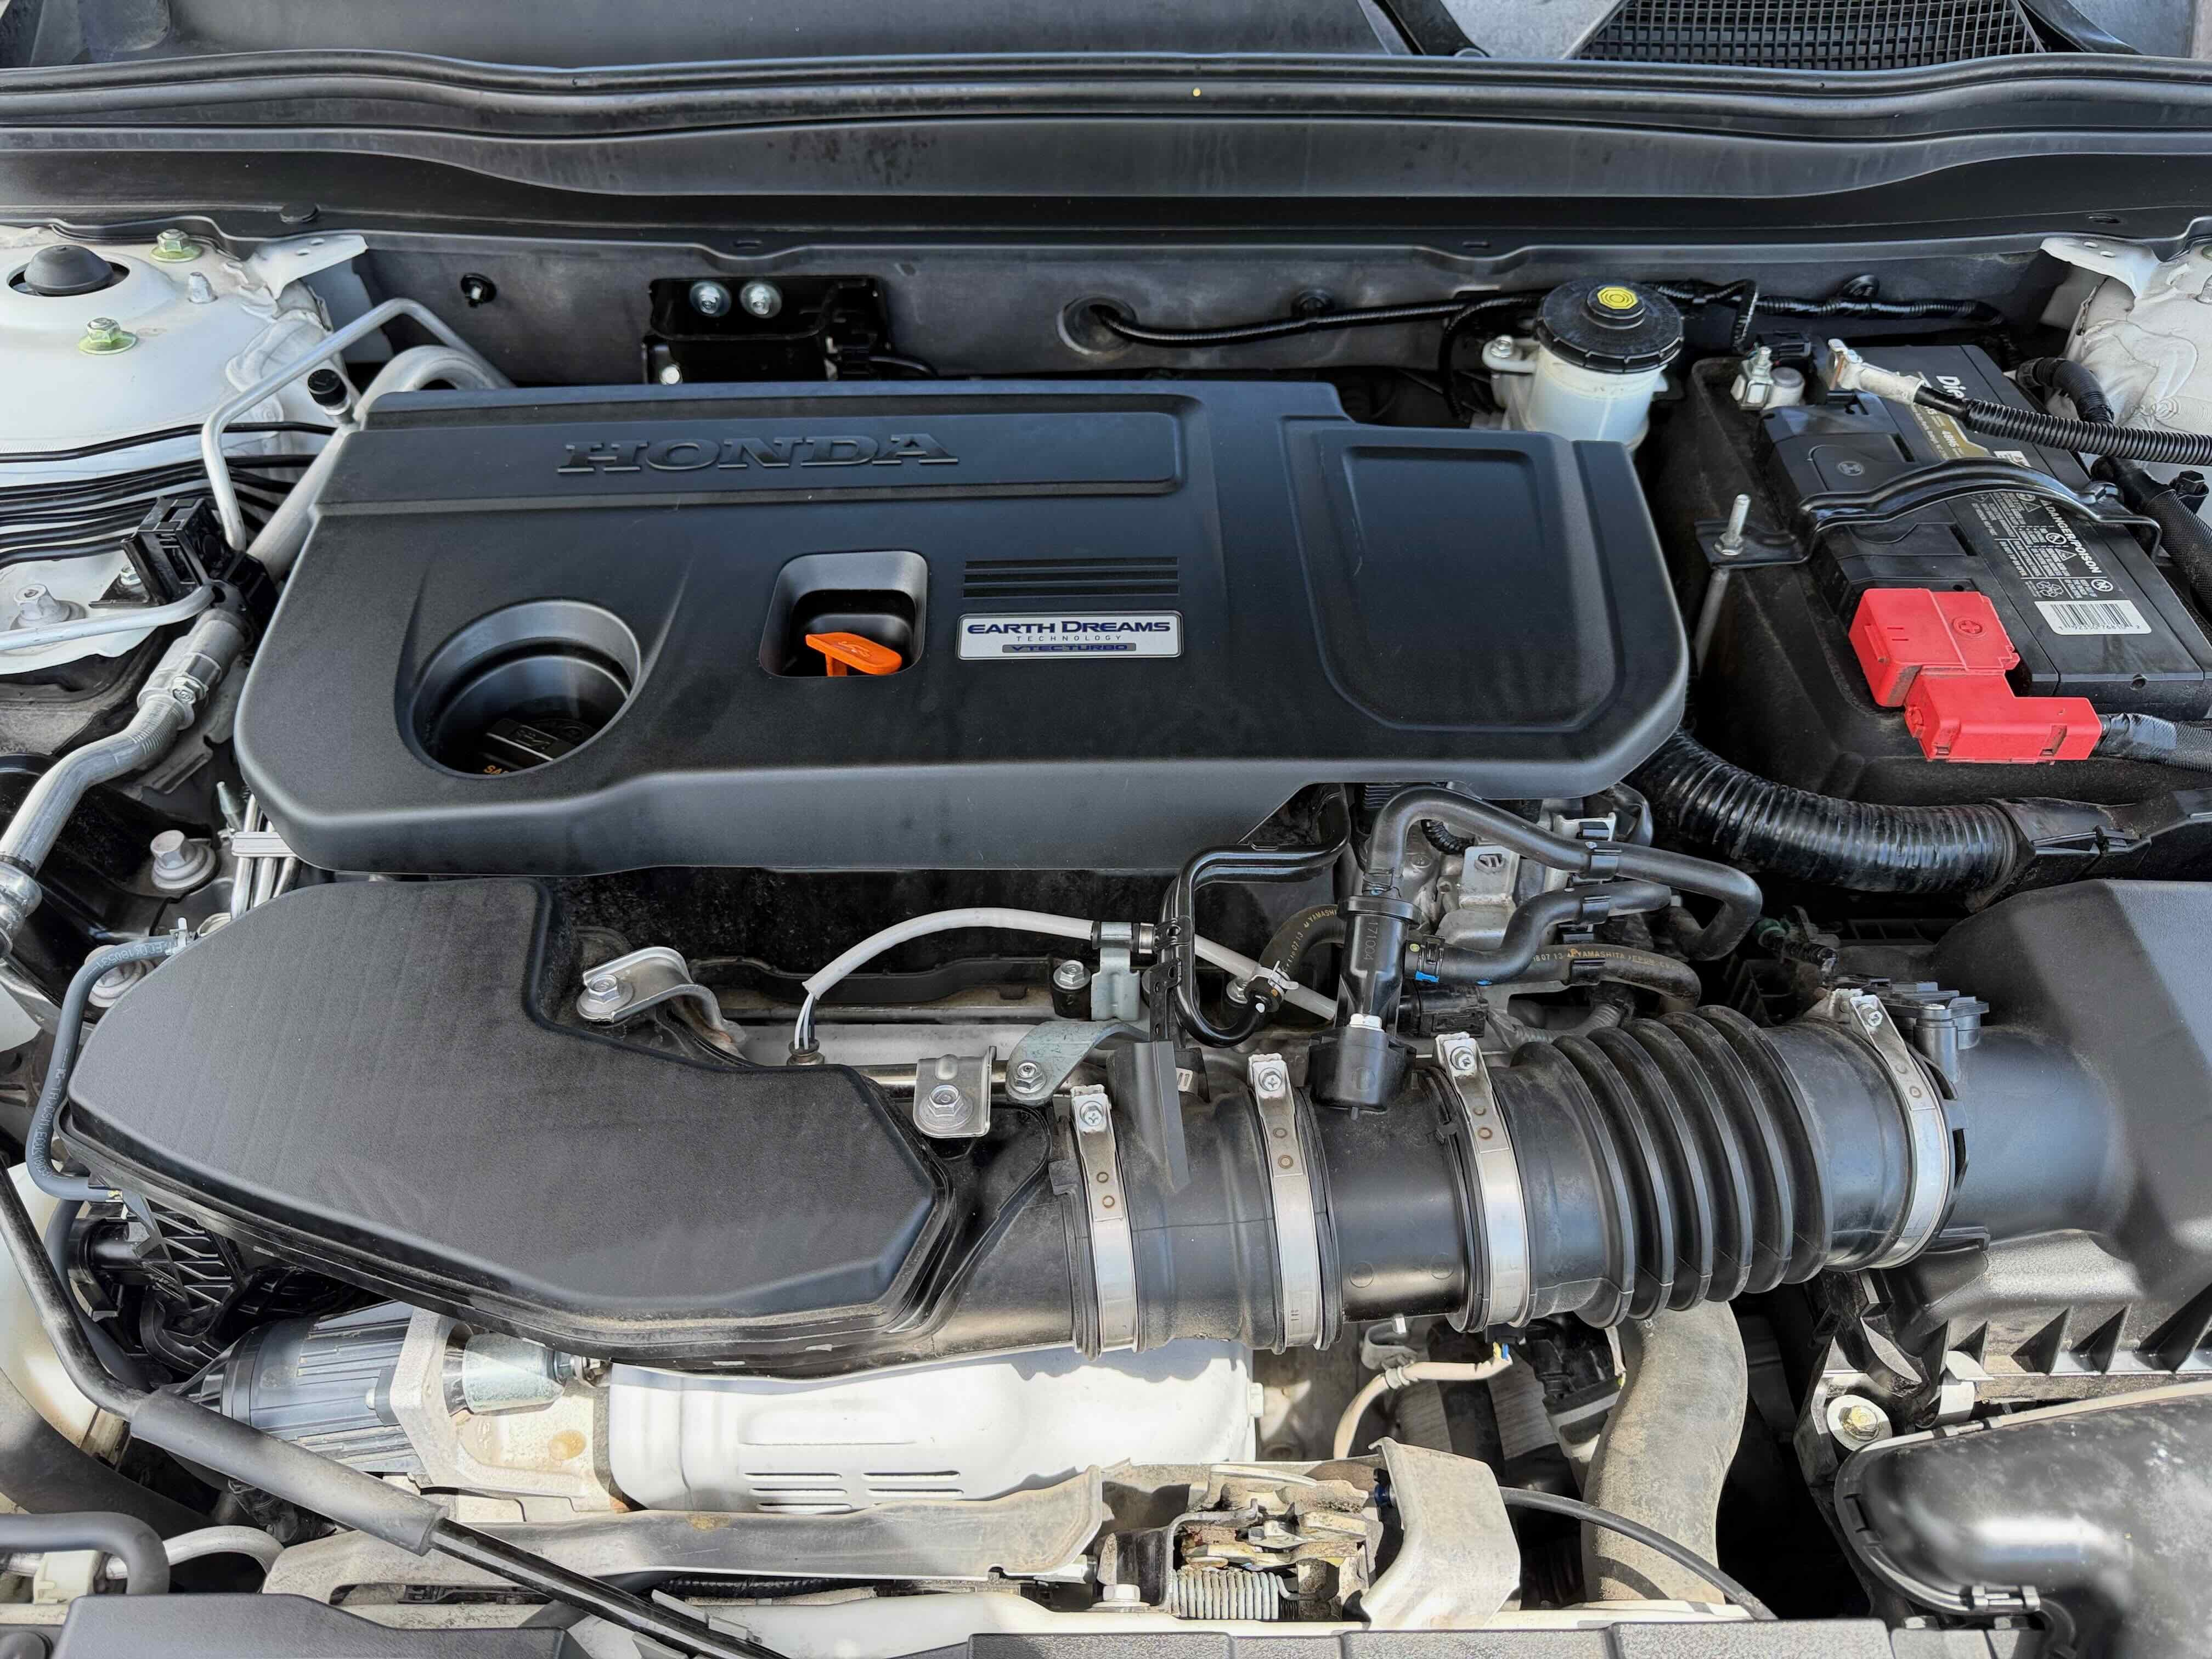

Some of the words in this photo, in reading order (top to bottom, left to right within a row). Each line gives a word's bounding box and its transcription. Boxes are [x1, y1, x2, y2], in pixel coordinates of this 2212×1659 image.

[557, 433, 960, 473] HONDA
[2044, 506, 2102, 573] DANGER/POISON
[967, 622, 1055, 634] EARTH
[1061, 620, 1171, 634] DREAMS
[483, 765, 510, 774] SA
